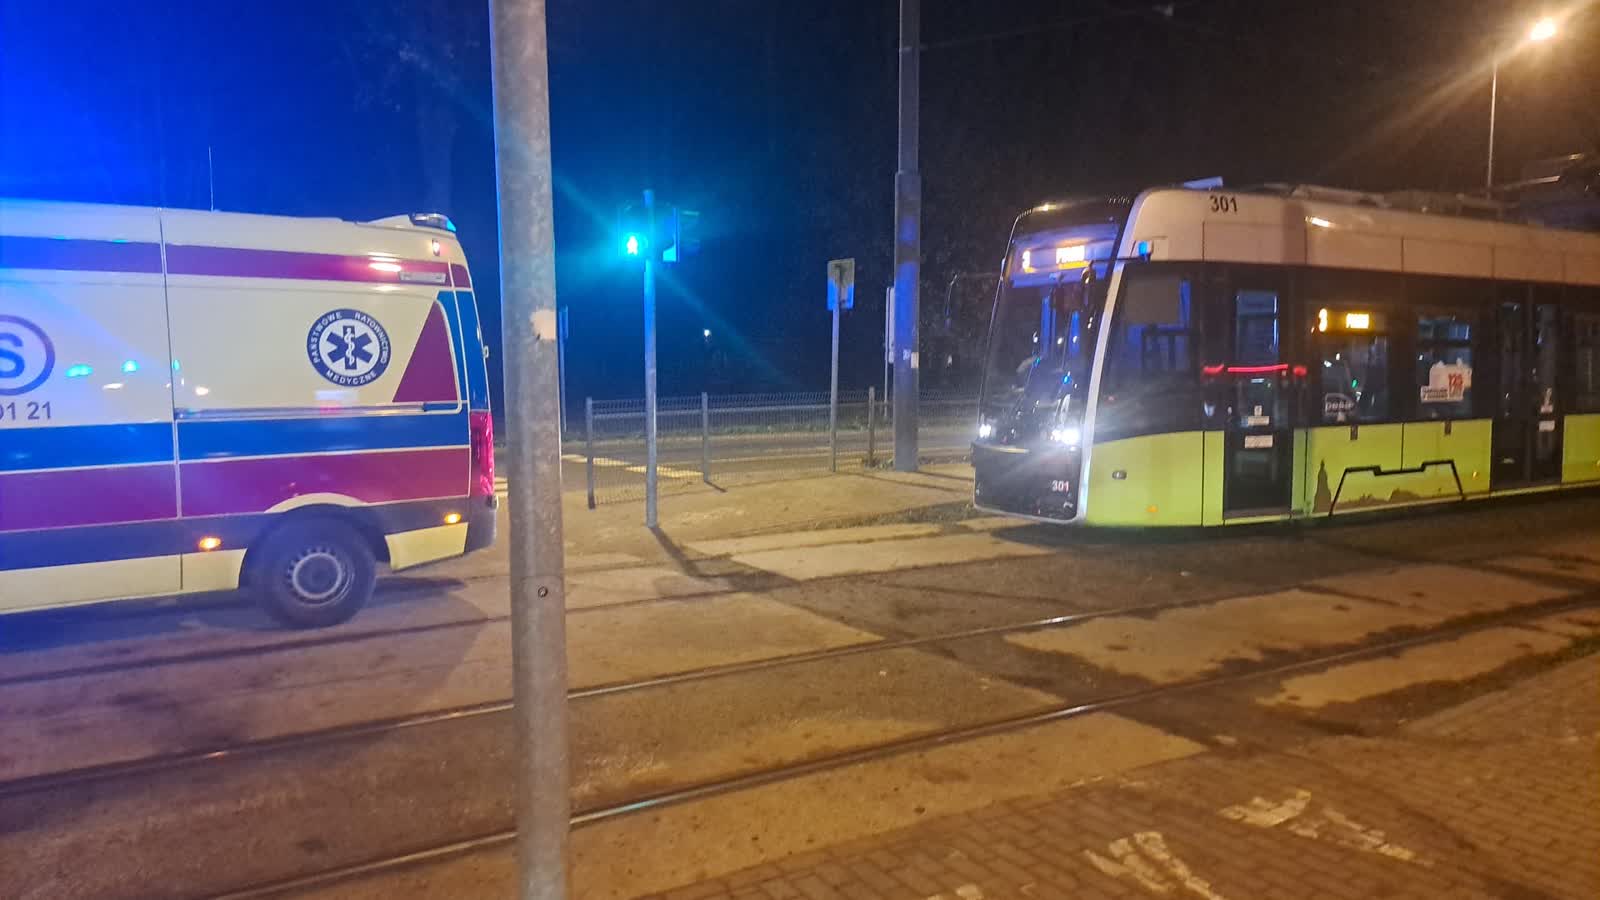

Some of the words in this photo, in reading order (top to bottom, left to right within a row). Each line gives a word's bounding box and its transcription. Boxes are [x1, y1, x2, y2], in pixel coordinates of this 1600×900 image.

[1210, 195, 1237, 212] 301
[1318, 307, 1328, 332] 3
[0, 332, 25, 378] S
[325, 369, 377, 385] MEDYCZNE
[26, 401, 52, 420] 21
[1051, 480, 1069, 492] 301
